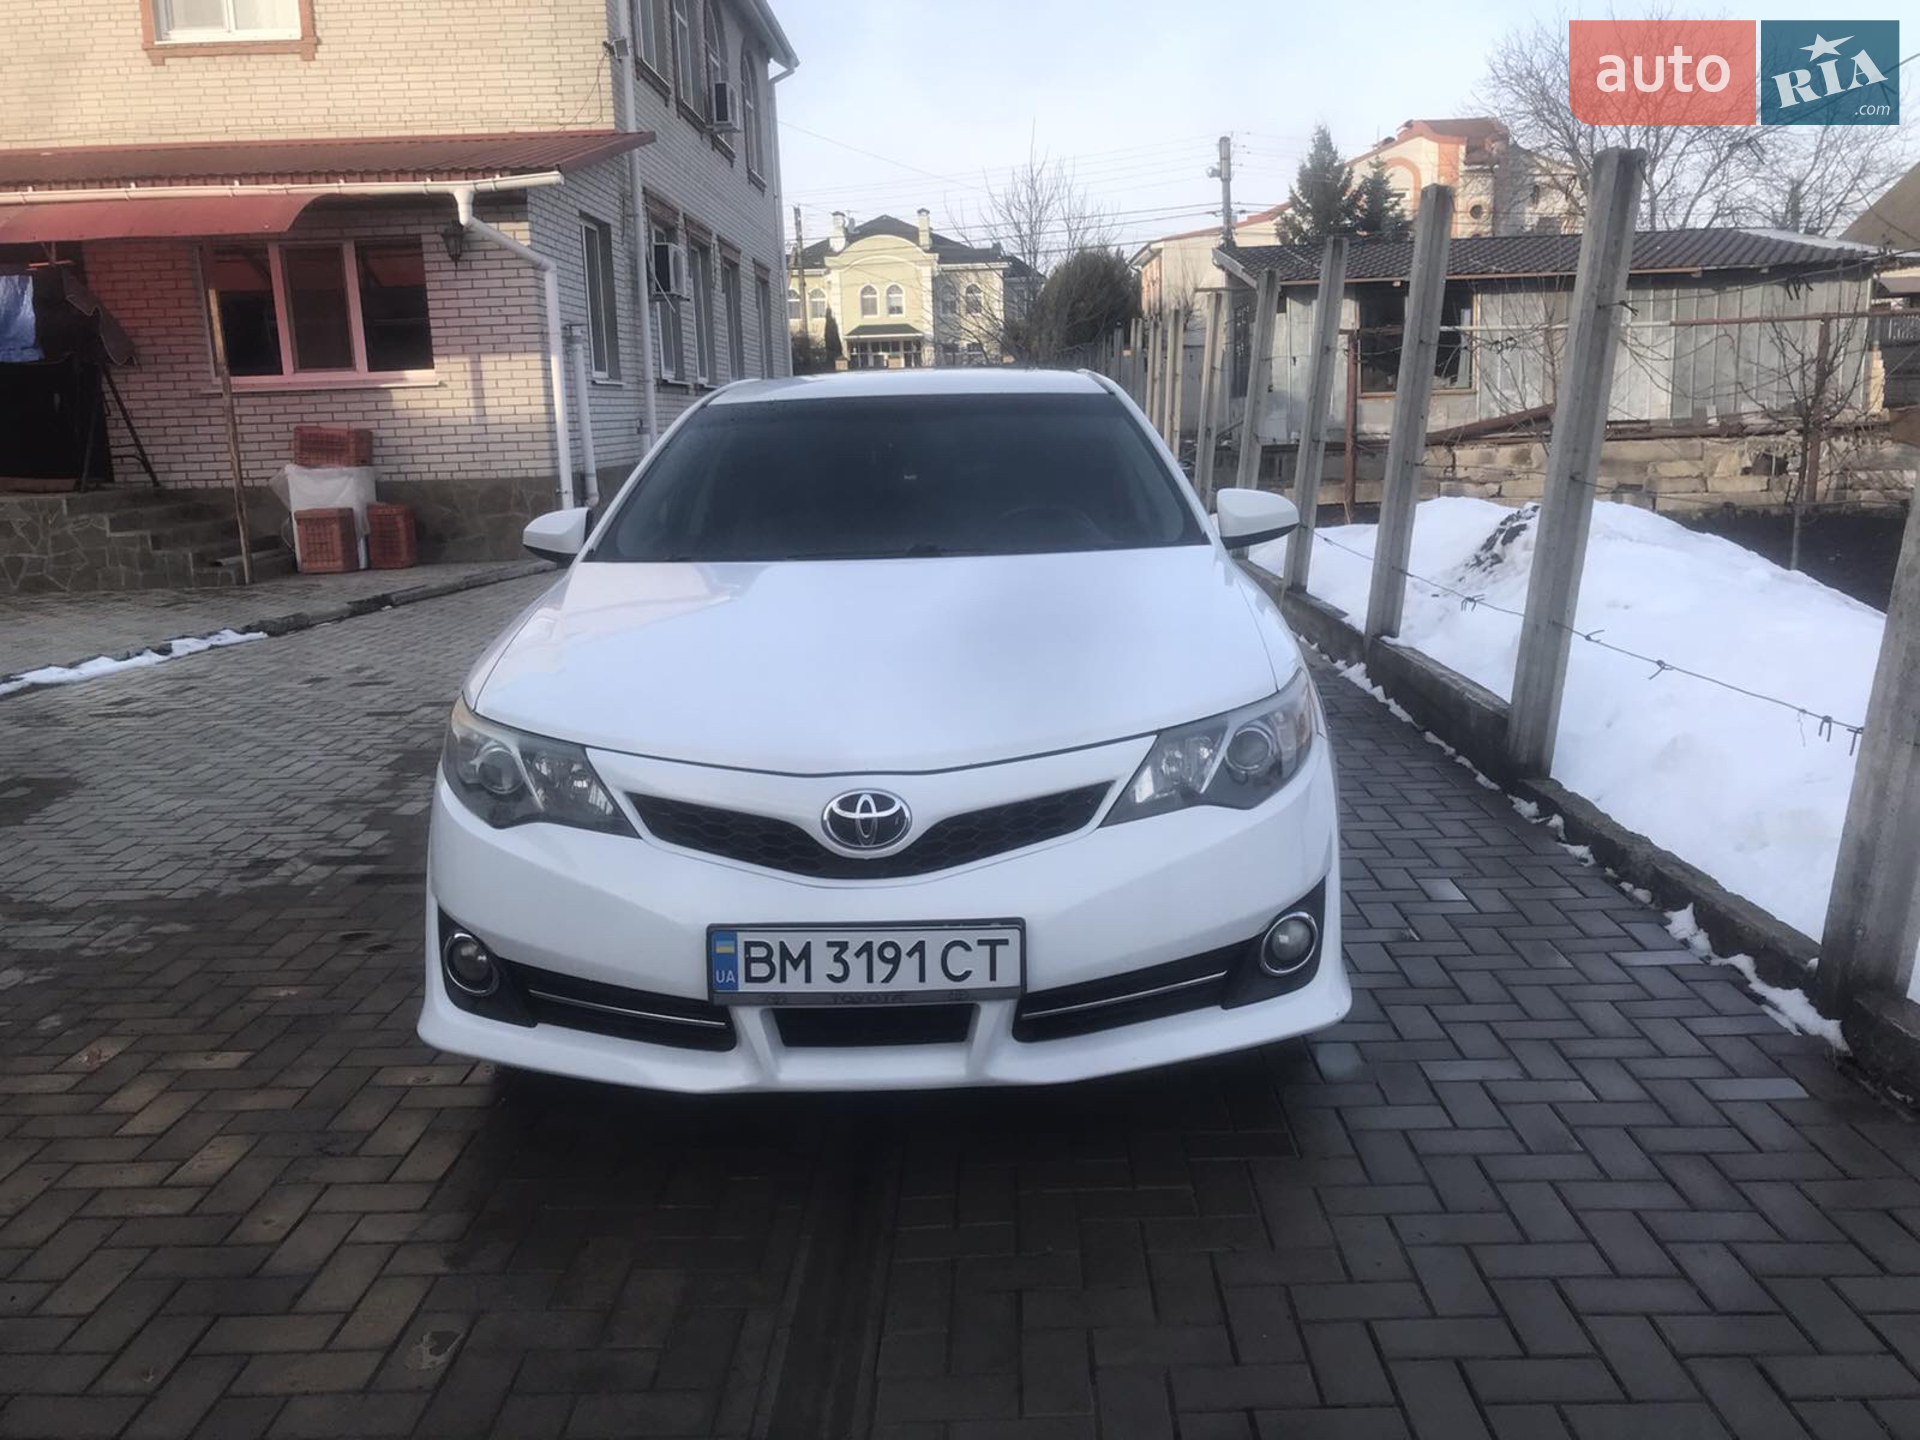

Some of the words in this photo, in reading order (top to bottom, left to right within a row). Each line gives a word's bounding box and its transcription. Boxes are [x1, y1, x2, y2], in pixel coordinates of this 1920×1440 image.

[743, 940, 812, 984] BM
[825, 940, 926, 984] 3191
[940, 938, 1009, 983] CT
[715, 970, 736, 984] UA
